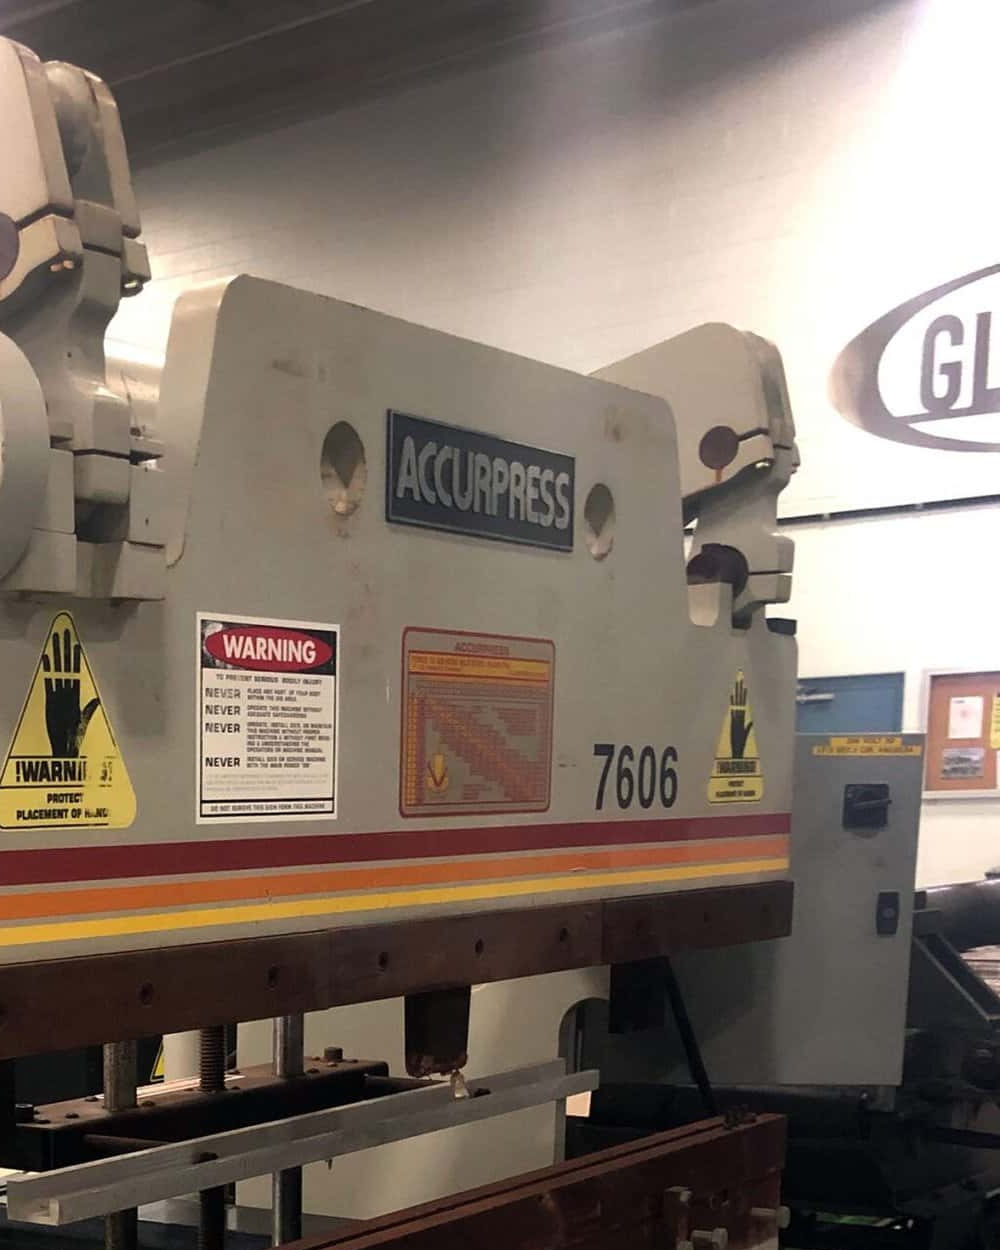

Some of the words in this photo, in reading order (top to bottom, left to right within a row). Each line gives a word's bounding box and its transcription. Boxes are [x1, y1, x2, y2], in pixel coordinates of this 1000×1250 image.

[396, 435, 570, 529] ACCURPRESS
[222, 634, 316, 664] WARNING
[205, 688, 241, 698] NEVER
[205, 705, 240, 715] NEVER
[205, 722, 240, 733] NEVER
[205, 757, 240, 767] NEVER
[594, 743, 678, 810] 7606
[16, 808, 69, 821] PLACEMENT
[71, 807, 81, 819] OF
